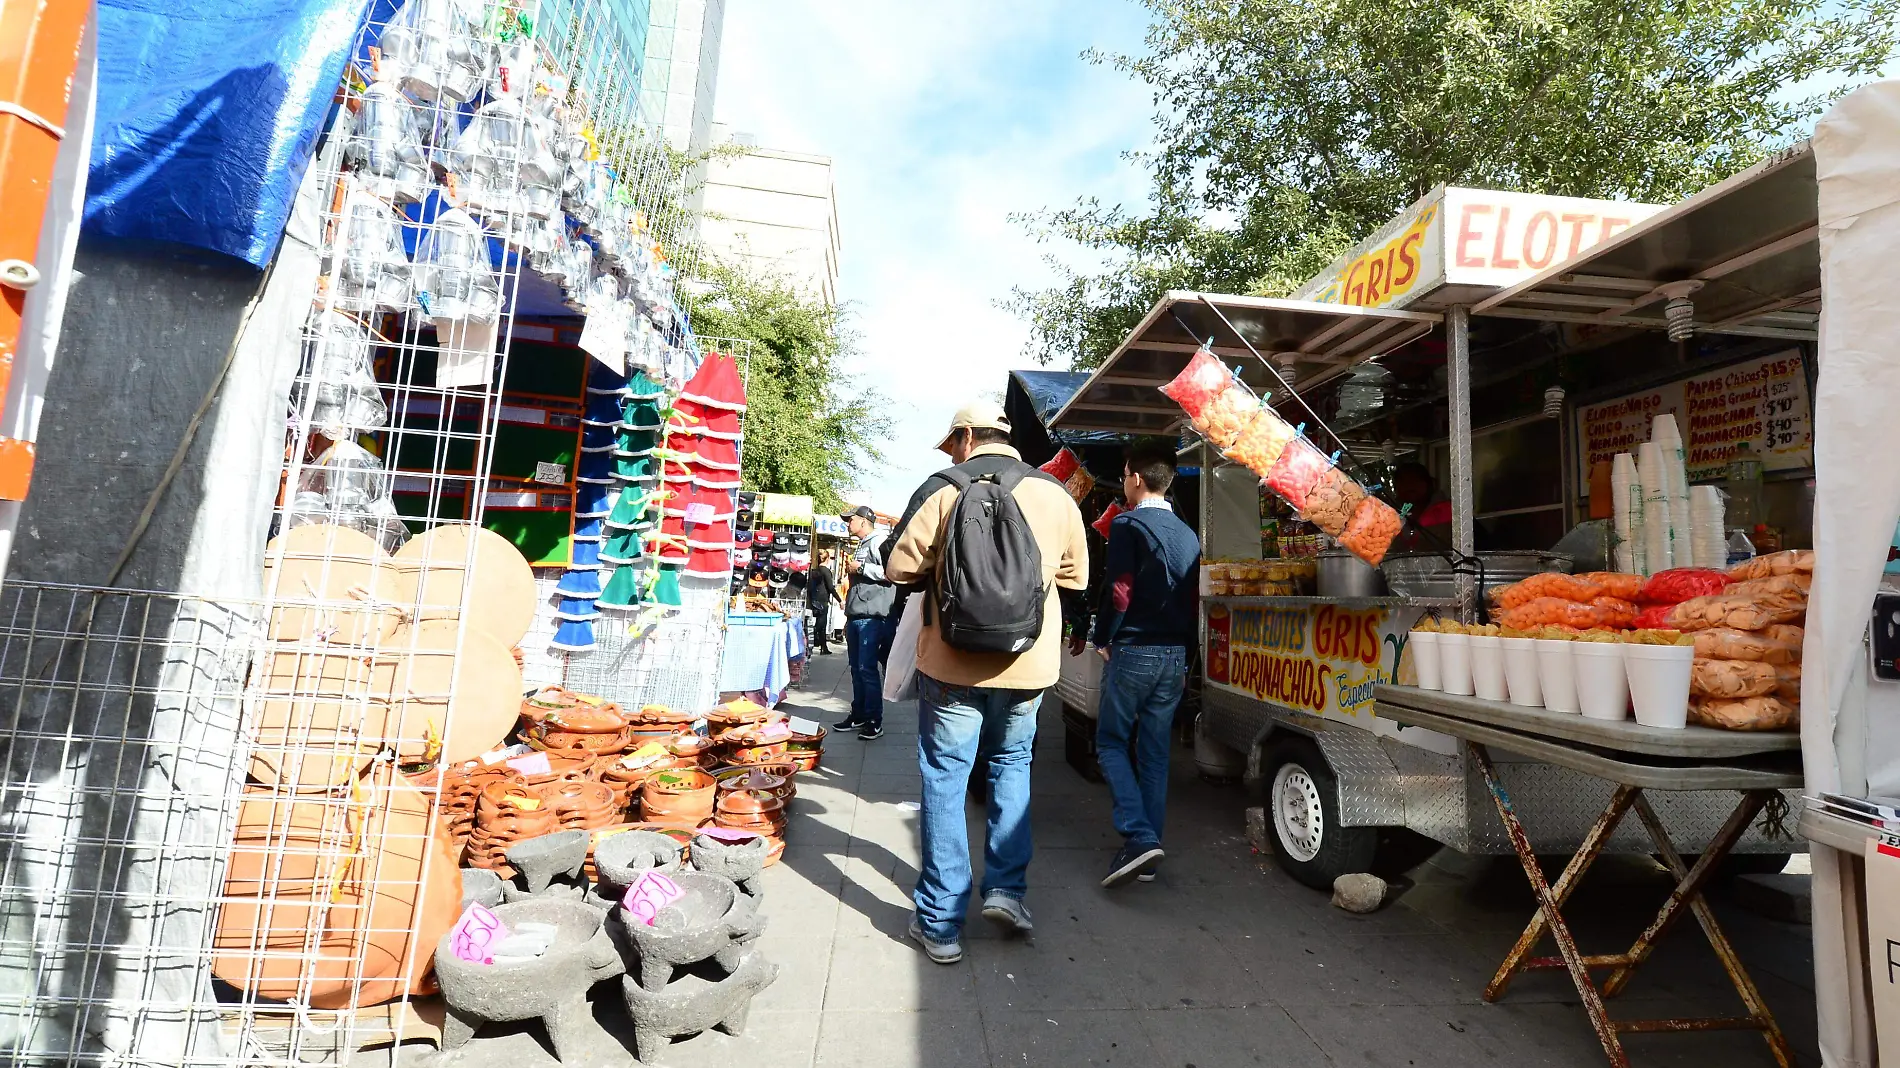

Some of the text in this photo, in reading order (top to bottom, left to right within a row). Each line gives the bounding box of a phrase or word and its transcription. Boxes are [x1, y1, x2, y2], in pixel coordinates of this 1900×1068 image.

[1687, 378, 1723, 397] PAPAS
[1689, 394, 1726, 414] PAPAS
[1691, 421, 1763, 445] DORINACHOS
[1263, 609, 1307, 650] ELOTES
[1231, 651, 1331, 711] DORINACHOS
